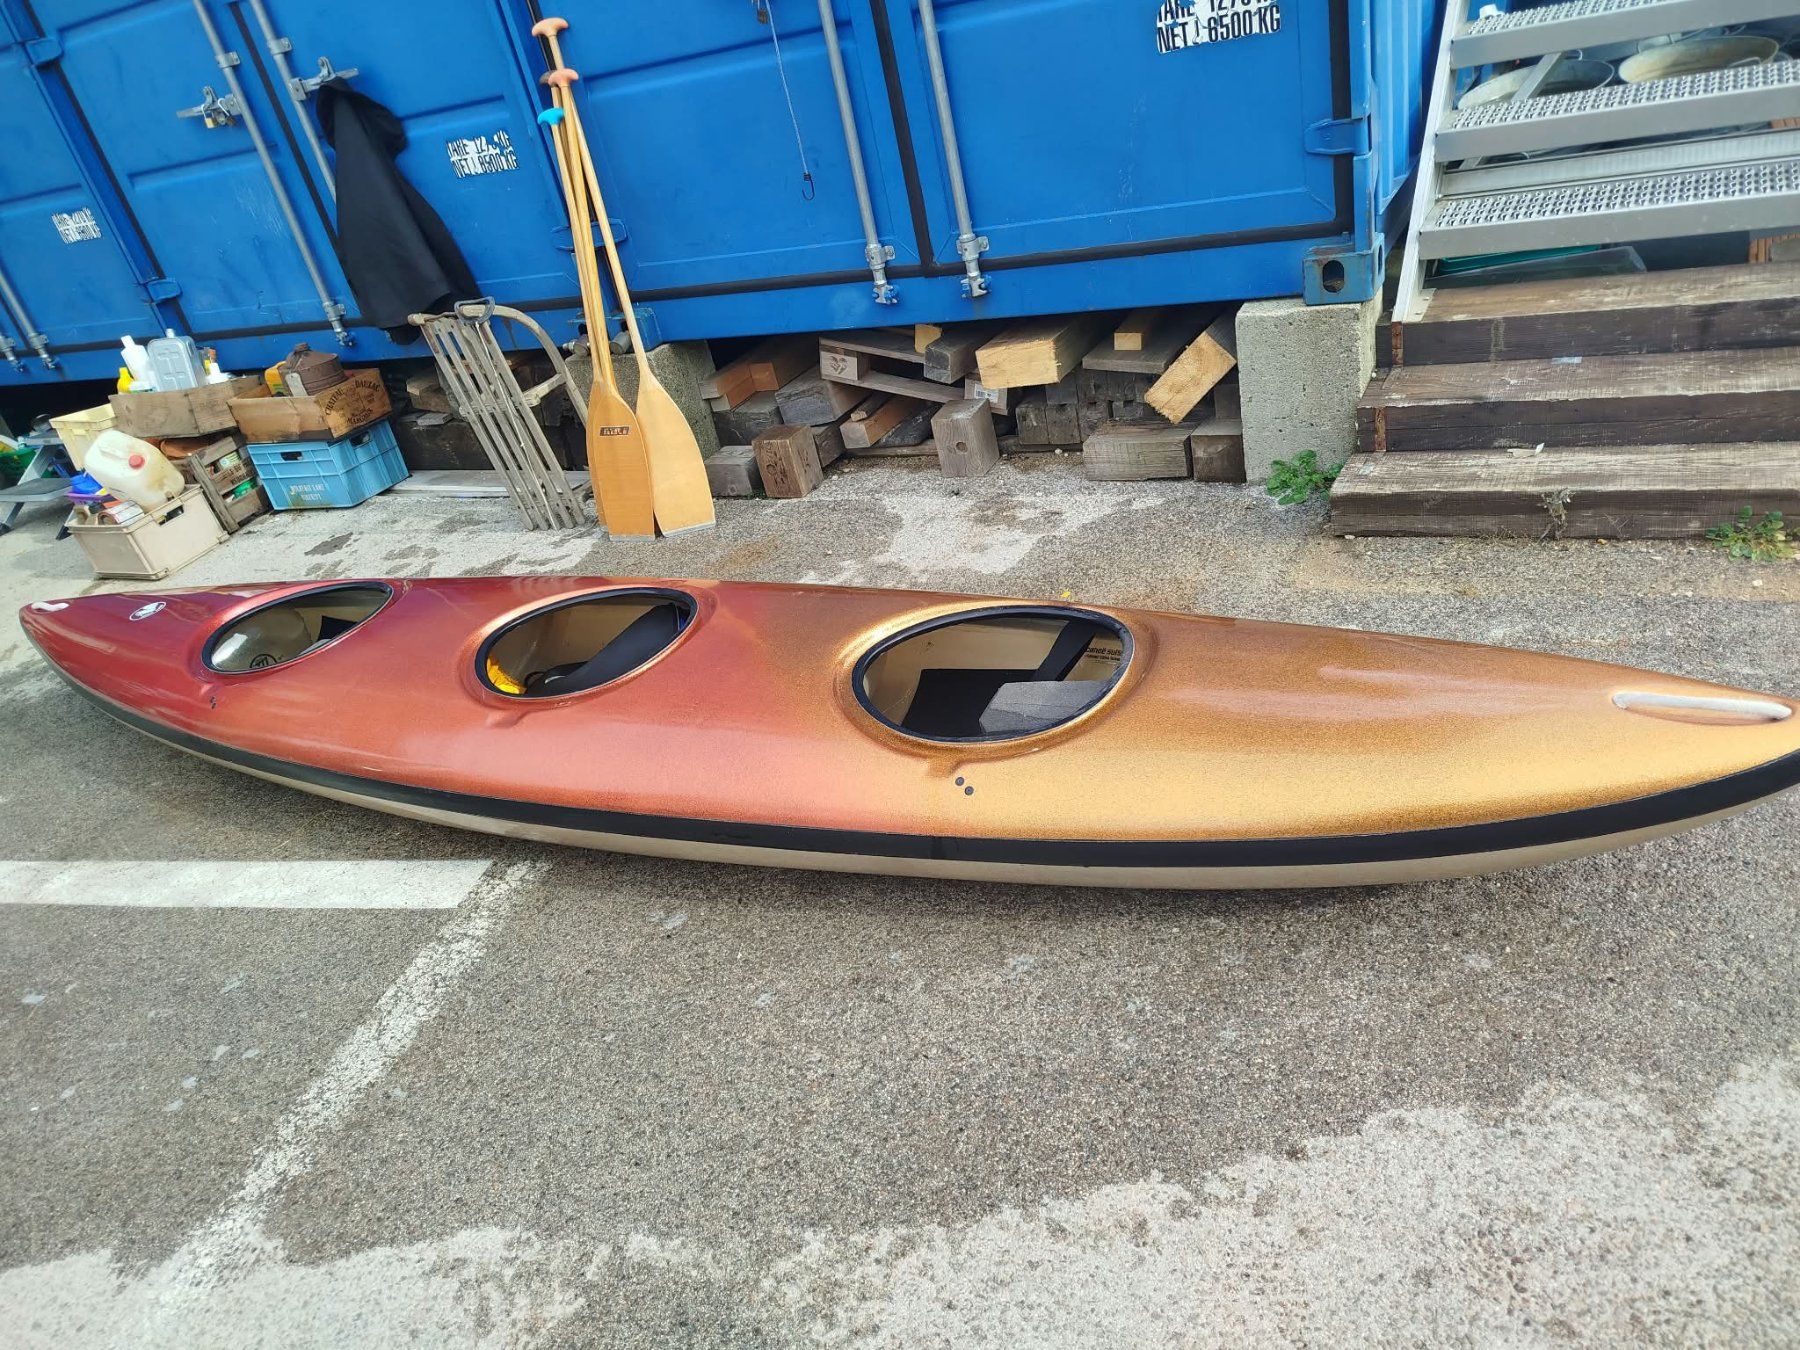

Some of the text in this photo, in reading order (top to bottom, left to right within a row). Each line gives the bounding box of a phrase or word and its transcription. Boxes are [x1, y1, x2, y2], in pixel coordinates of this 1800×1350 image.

[1157, 4, 1281, 53] NET 6500 KG
